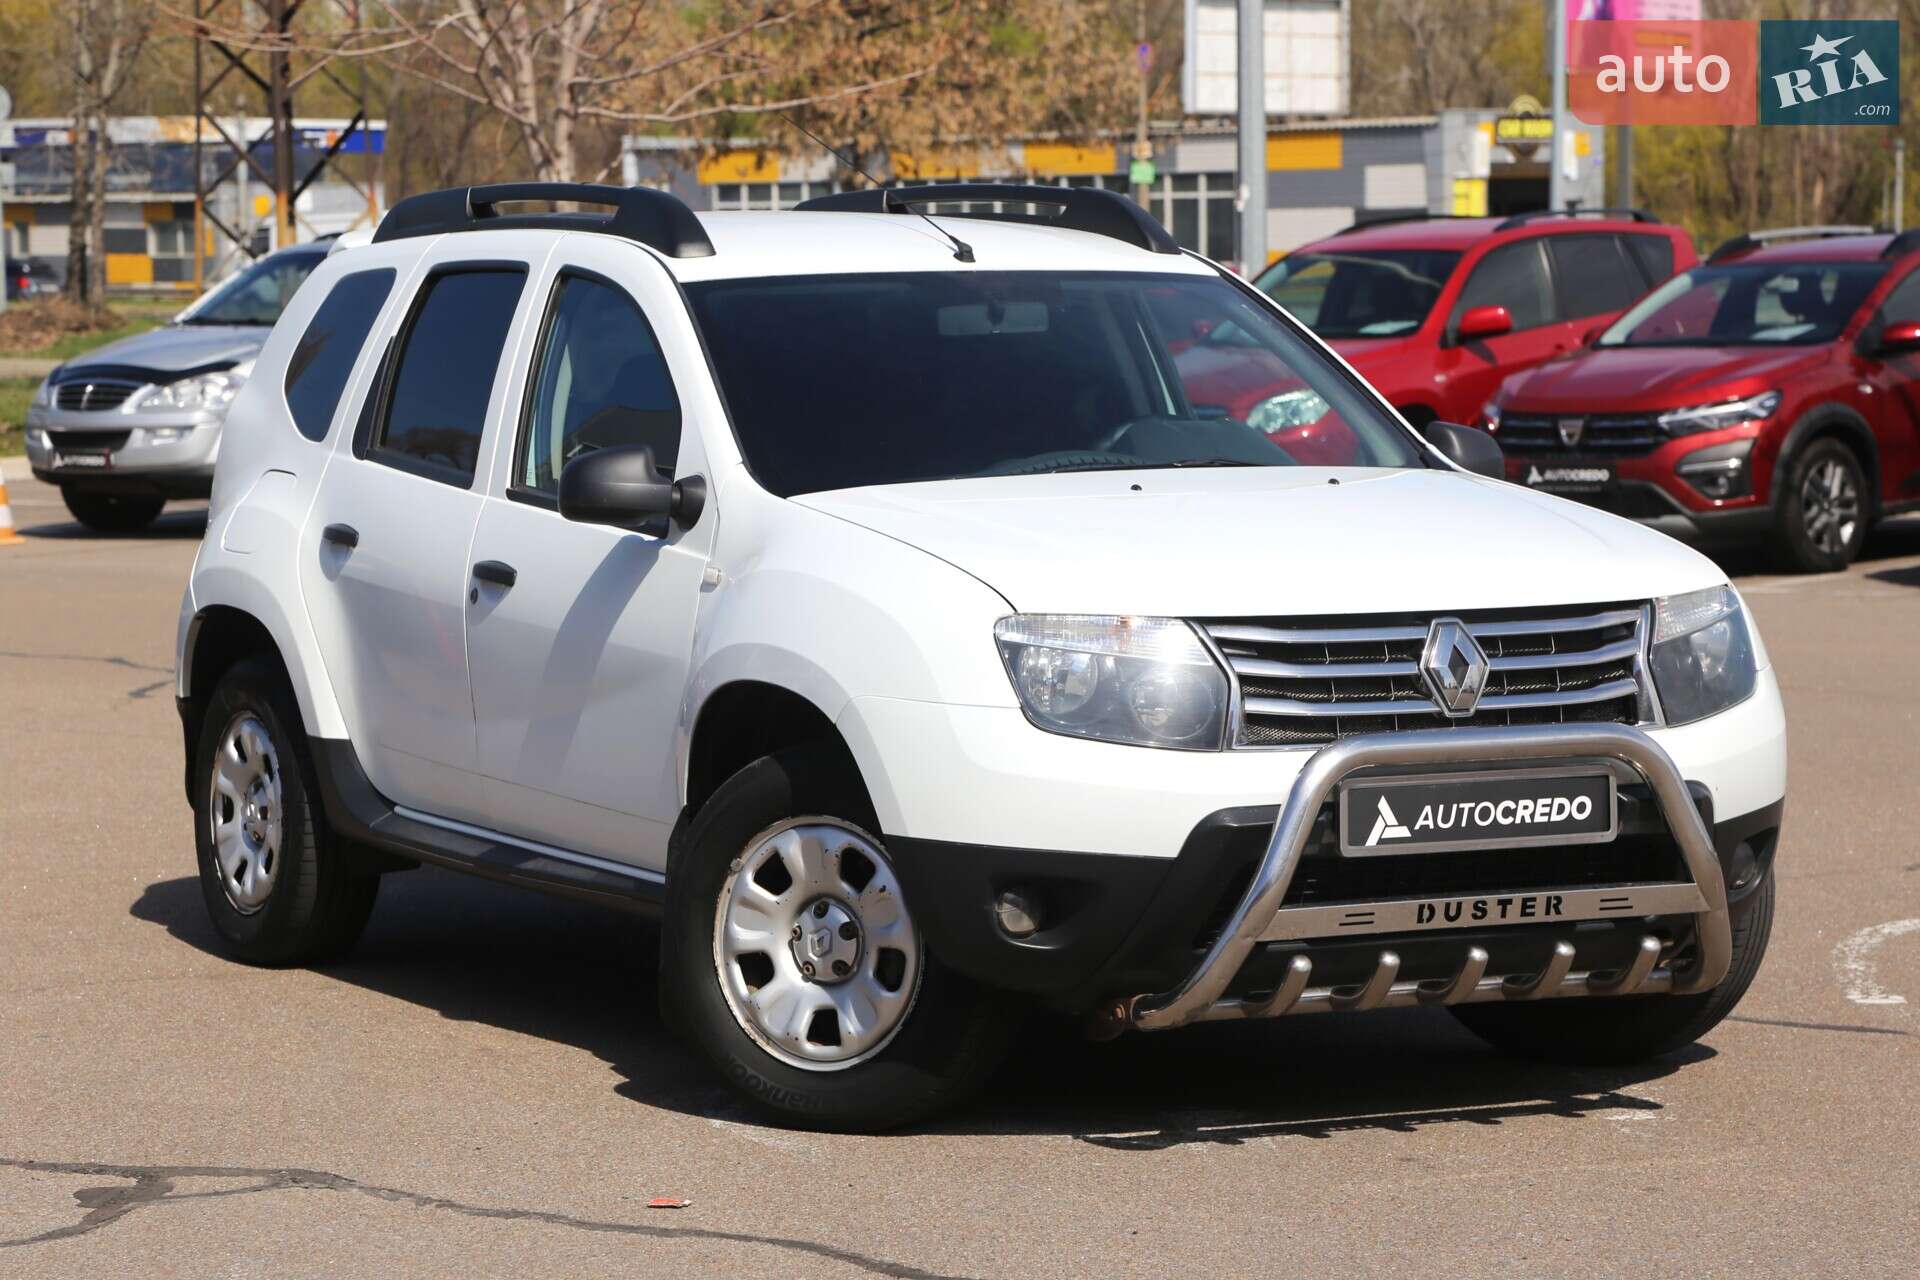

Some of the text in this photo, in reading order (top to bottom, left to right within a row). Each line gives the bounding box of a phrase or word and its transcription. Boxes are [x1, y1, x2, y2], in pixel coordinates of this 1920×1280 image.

[1543, 468, 1610, 482] AUTOCREDO
[1414, 795, 1593, 831] AUTOCREDO
[1416, 895, 1564, 925] DUSTER
